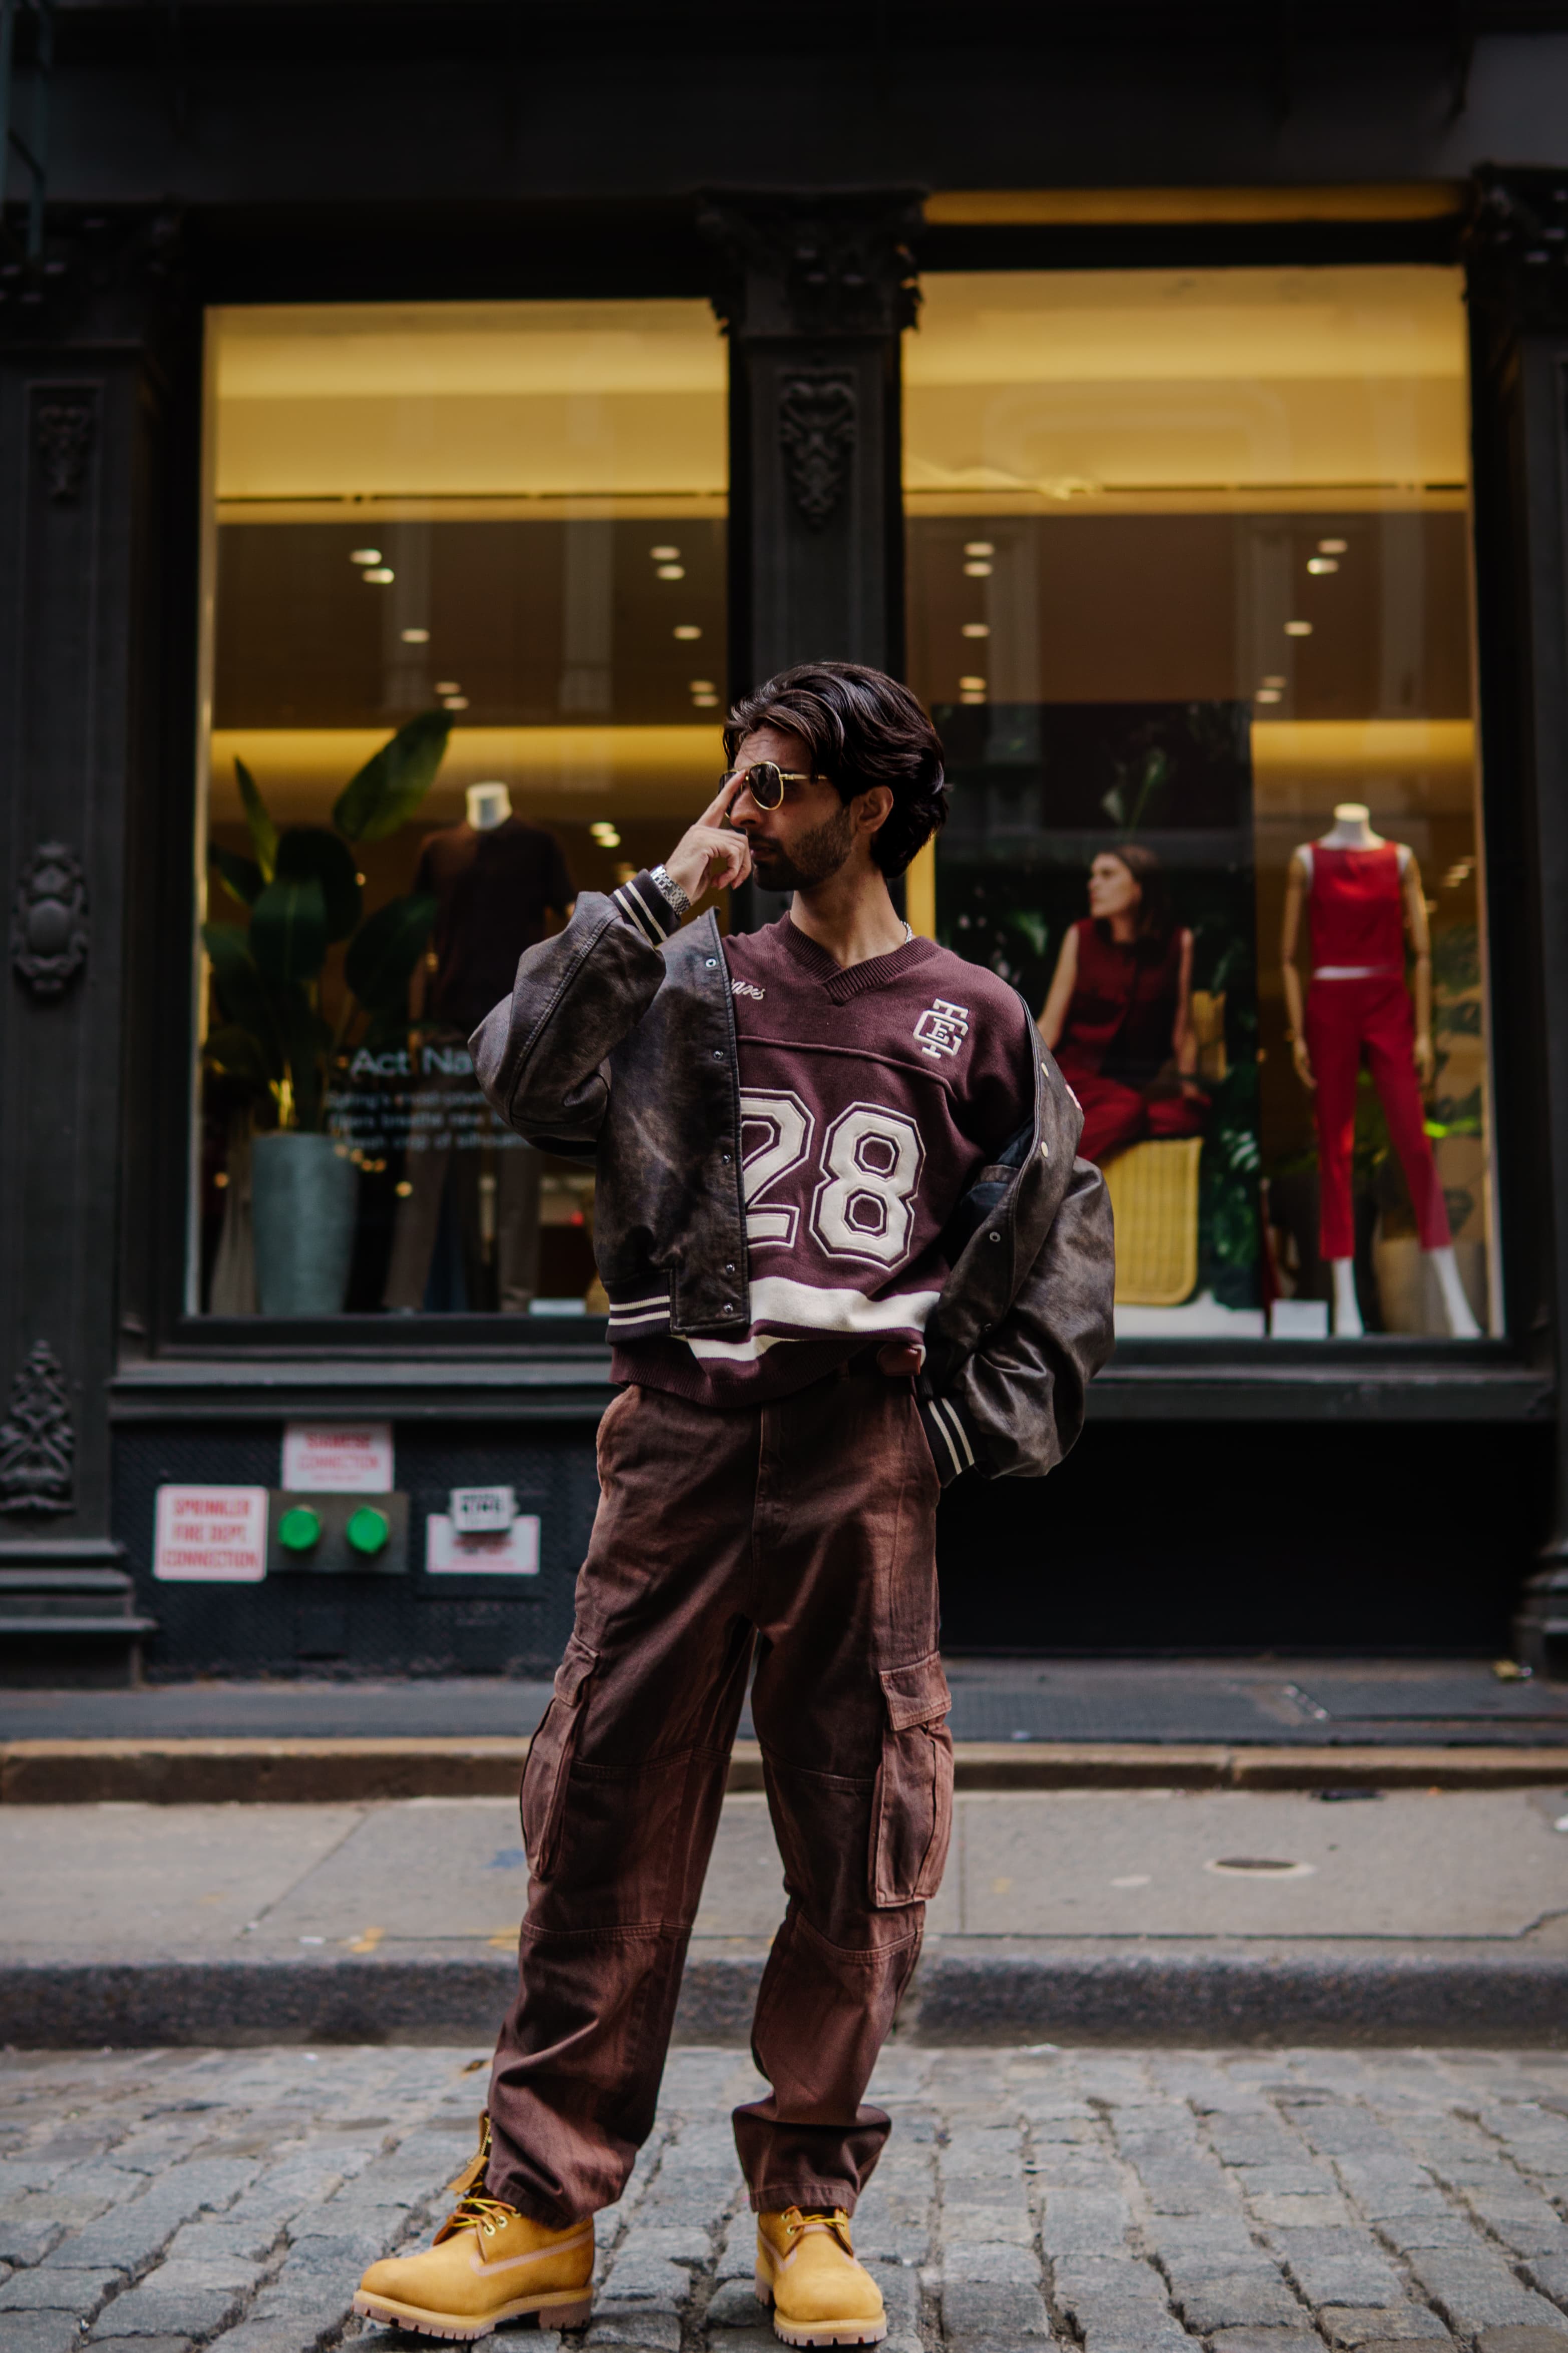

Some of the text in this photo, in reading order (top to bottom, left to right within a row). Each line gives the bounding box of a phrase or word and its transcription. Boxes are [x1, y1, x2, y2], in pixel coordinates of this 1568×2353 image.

[351, 1048, 411, 1076] Act
[739, 1087, 926, 1272] 28
[173, 1499, 251, 1517] SPRINKLER
[172, 1523, 204, 1542] FIRE
[163, 1548, 258, 1568] CONNECTION
